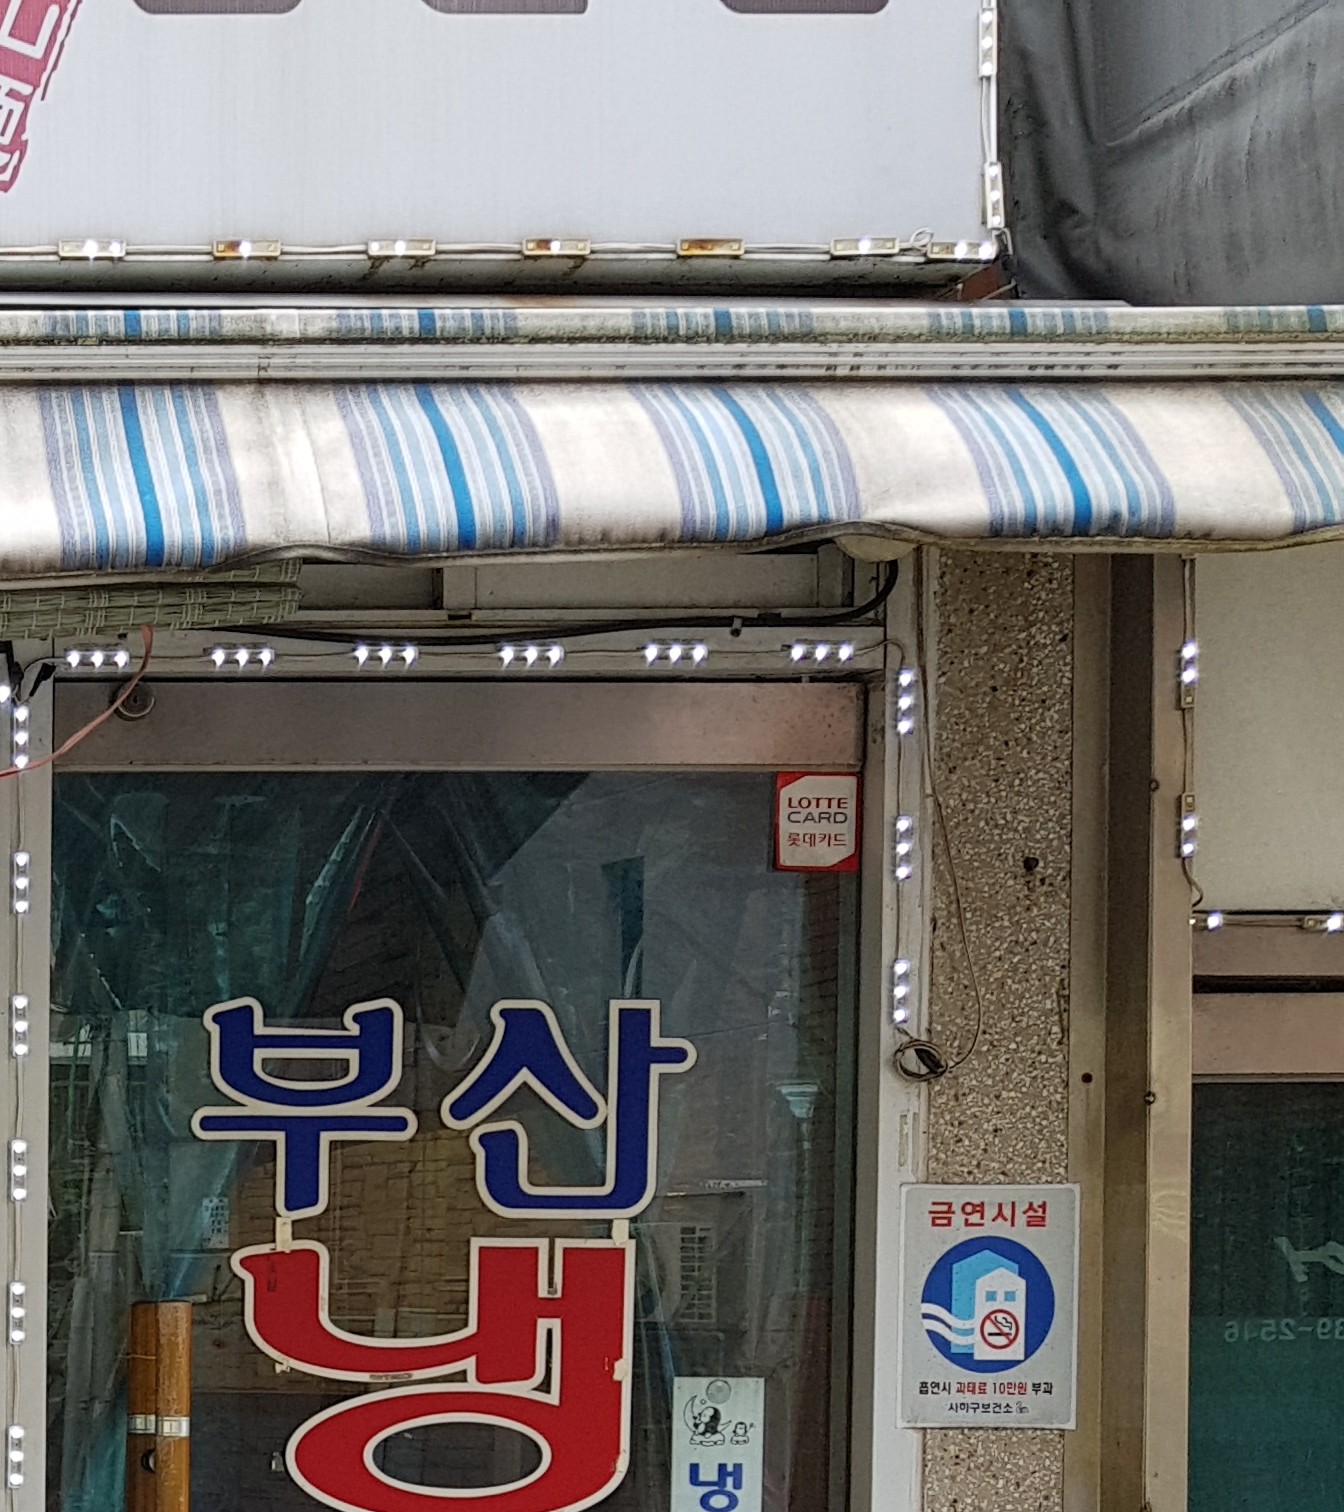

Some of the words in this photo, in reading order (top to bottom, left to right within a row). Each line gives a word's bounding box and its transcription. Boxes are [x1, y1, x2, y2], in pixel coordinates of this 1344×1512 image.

[787, 796, 849, 809] LOTTE
[787, 811, 848, 824] CARD
[788, 832, 847, 848] 롯데카드
[191, 996, 698, 1219] 부산
[928, 1201, 1048, 1228] 금연시설
[919, 1381, 951, 1395] 흡연시
[956, 1381, 987, 1395] 과태료
[992, 1381, 1027, 1395] 10만원
[1031, 1382, 1053, 1396] 부과
[948, 1401, 1013, 1414] 사하구보건소
